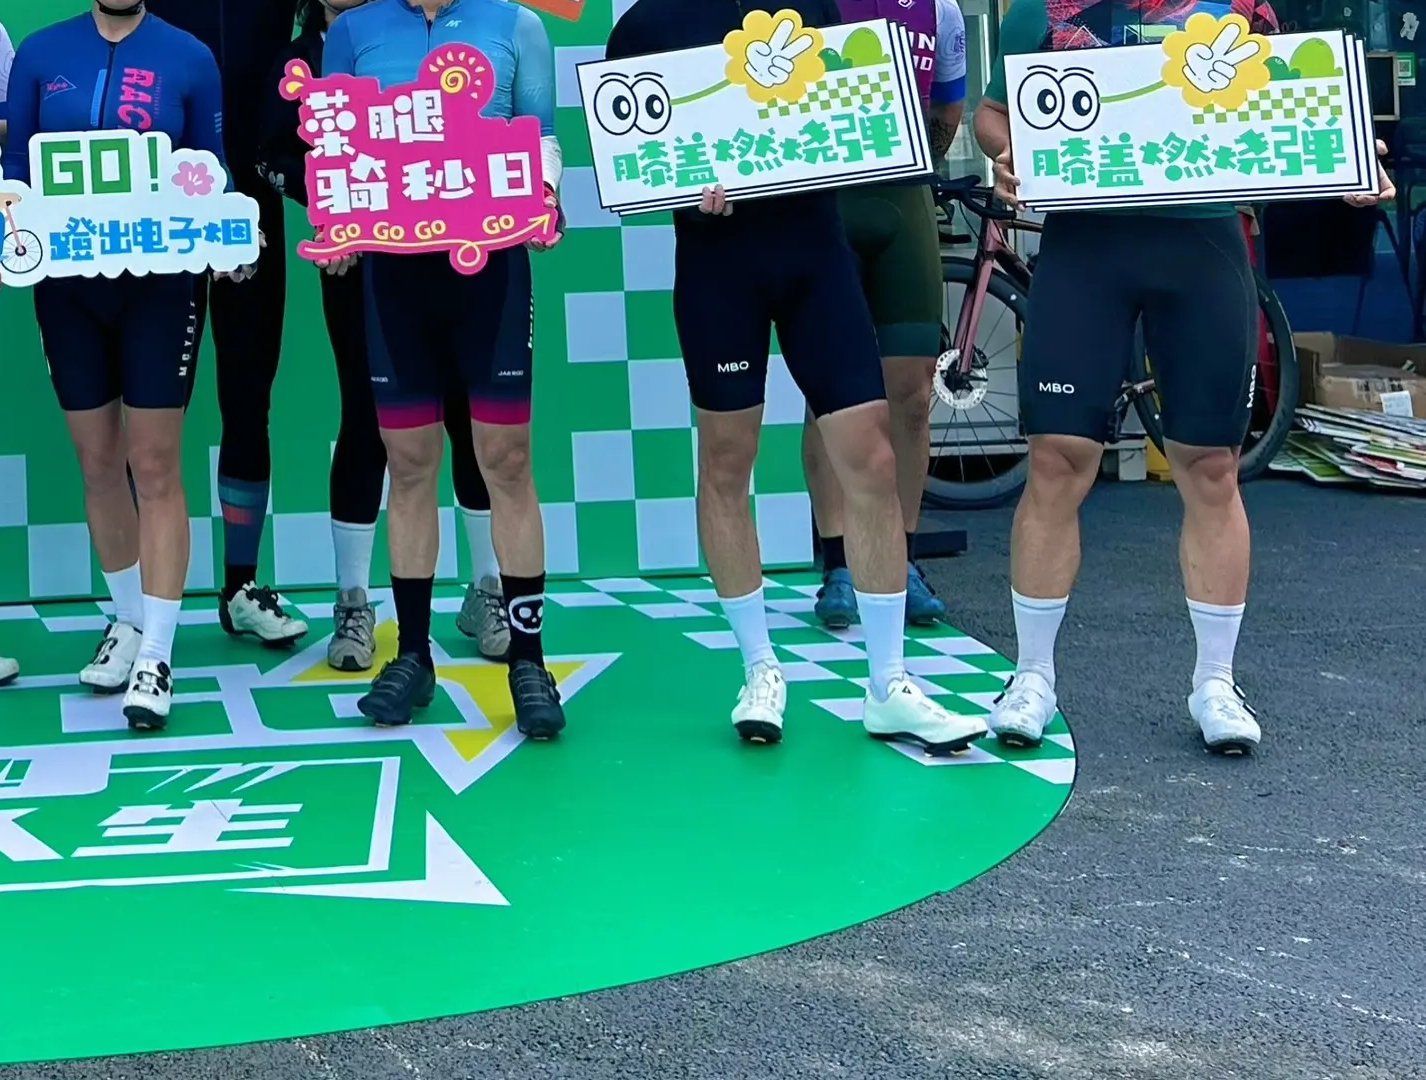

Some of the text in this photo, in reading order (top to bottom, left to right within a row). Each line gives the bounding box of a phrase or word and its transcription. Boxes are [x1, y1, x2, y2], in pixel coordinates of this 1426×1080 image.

[117, 68, 156, 130] RAC
[305, 89, 445, 159] 菜腿
[40, 136, 159, 197] GO!
[612, 101, 903, 188] 膝盖燃烧弹
[1032, 116, 1347, 189] 膝盖燃烧弹
[315, 151, 534, 215] 骑秒日
[329, 214, 515, 244] GO GO GO GO
[717, 360, 749, 373] MBO
[1038, 381, 1075, 395] MBO
